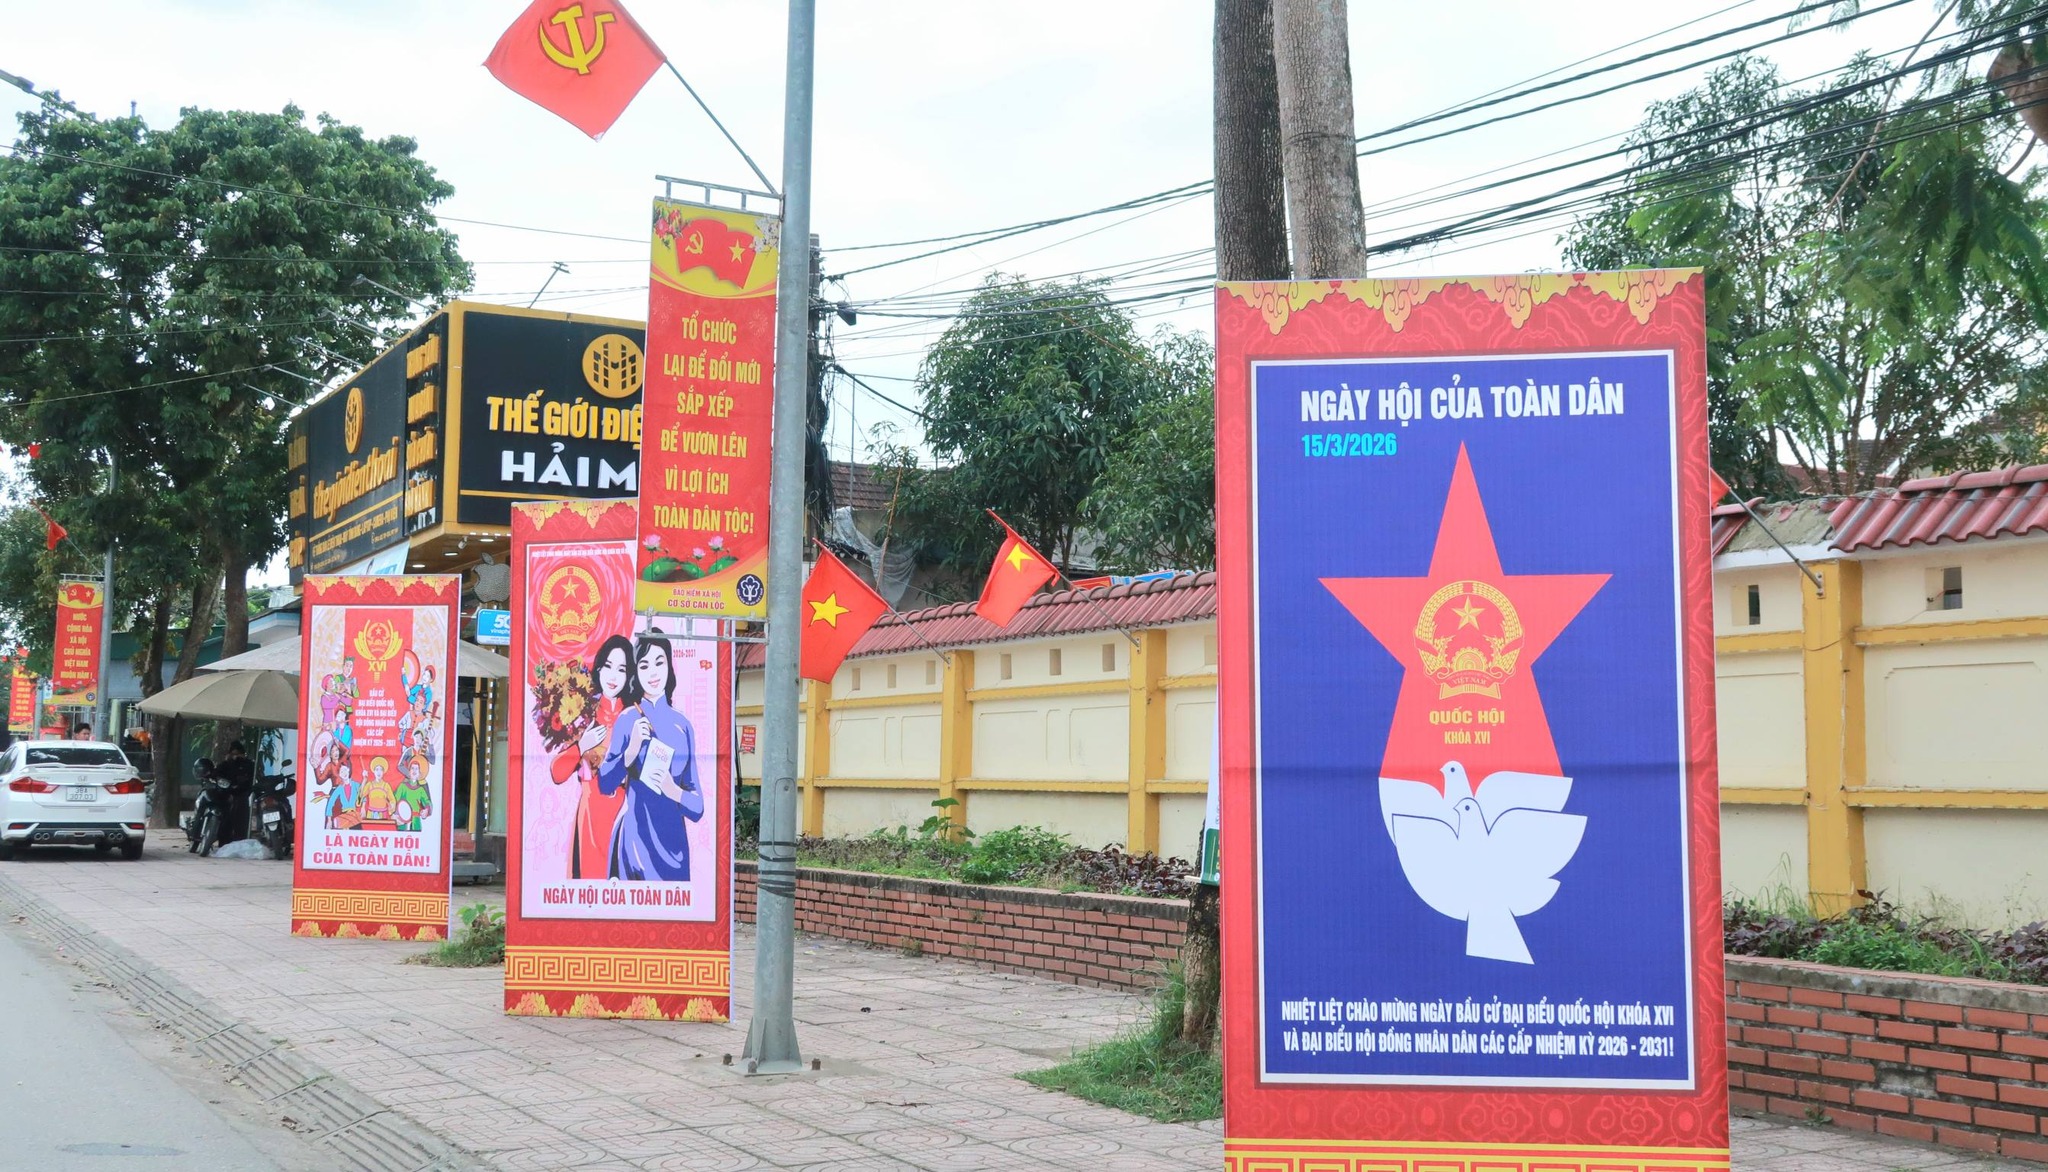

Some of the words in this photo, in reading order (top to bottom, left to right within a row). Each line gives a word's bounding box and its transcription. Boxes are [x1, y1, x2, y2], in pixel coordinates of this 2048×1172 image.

[682, 309, 698, 340] TỔ
[702, 317, 737, 345] CHỨC
[663, 353, 684, 381] LẠI
[688, 348, 707, 380] ĐỂ
[709, 351, 732, 382] ĐỔI
[735, 357, 761, 385] MỚI
[676, 384, 704, 415] SẮP
[707, 389, 734, 418] XẾP
[1301, 383, 1371, 422] NGÀY
[1379, 382, 1422, 427] HỘI
[1430, 374, 1484, 419] CỦA
[1490, 379, 1560, 418] TOÀN
[1568, 376, 1624, 415] DÂN
[486, 389, 545, 434] THẾ
[543, 397, 599, 439] GIỚI
[601, 403, 642, 450] ĐIỆ
[660, 421, 680, 452] ĐỂ
[682, 430, 718, 456] VƯƠN
[722, 431, 747, 458] LÊN
[1301, 432, 1398, 458] 15/3/2026
[501, 441, 590, 488] HẢI
[665, 463, 678, 491] VÌ
[681, 468, 702, 498] LỢI
[706, 467, 729, 495] ÍCH
[653, 501, 689, 530] TOÀN
[692, 504, 721, 532] DÂN
[724, 506, 754, 538] TỘC!
[368, 660, 387, 672] XVI
[1429, 706, 1473, 725] QUỐC
[1477, 708, 1505, 726] HỘI
[1444, 729, 1472, 744] KHÓA
[1474, 731, 1491, 744] XVI
[313, 847, 343, 864] CỦA
[349, 850, 388, 866] TOÀN
[393, 849, 430, 867] DÂN!
[325, 832, 343, 848] LÀ
[348, 833, 389, 849] NGÀY
[394, 834, 420, 851] HỘI
[543, 885, 575, 904] NGÀY
[578, 885, 598, 908] HỘI
[602, 881, 626, 905] CỦA
[629, 886, 662, 906] TOÀN
[665, 886, 691, 906] DÂN
[1281, 997, 1316, 1025] NHIỆT
[1318, 997, 1344, 1025] LIỆT
[1345, 998, 1378, 1022] CHÀO
[1381, 997, 1417, 1022] MỪNG
[1420, 998, 1453, 1023] NGÀY
[1455, 996, 1481, 1023] BẦU
[1483, 995, 1502, 1024] CỬ
[1502, 1003, 1524, 1028] ĐẠI
[1526, 996, 1555, 1024] BIỂU
[1557, 997, 1591, 1027] QUỐC
[1593, 1001, 1615, 1029] HỘI
[1617, 1001, 1652, 1026] KHÓA
[1654, 1005, 1674, 1026] XVI
[1283, 1027, 1300, 1052] VÀ
[1302, 1031, 1322, 1056] ĐẠI
[1325, 1024, 1353, 1052] BIỂU
[1355, 1028, 1376, 1056] HỘI
[1378, 1026, 1412, 1052] ĐỒNG
[1415, 1029, 1449, 1053] NHÂN
[1452, 1029, 1477, 1054] DÂN
[1480, 1030, 1506, 1054] CÁC
[1508, 1027, 1533, 1055] CẤP
[1535, 1031, 1576, 1059] NHIỆM
[1579, 1031, 1595, 1056] KỲ
[1598, 1036, 1628, 1056] 2026
[1639, 1036, 1674, 1057] 2031!
